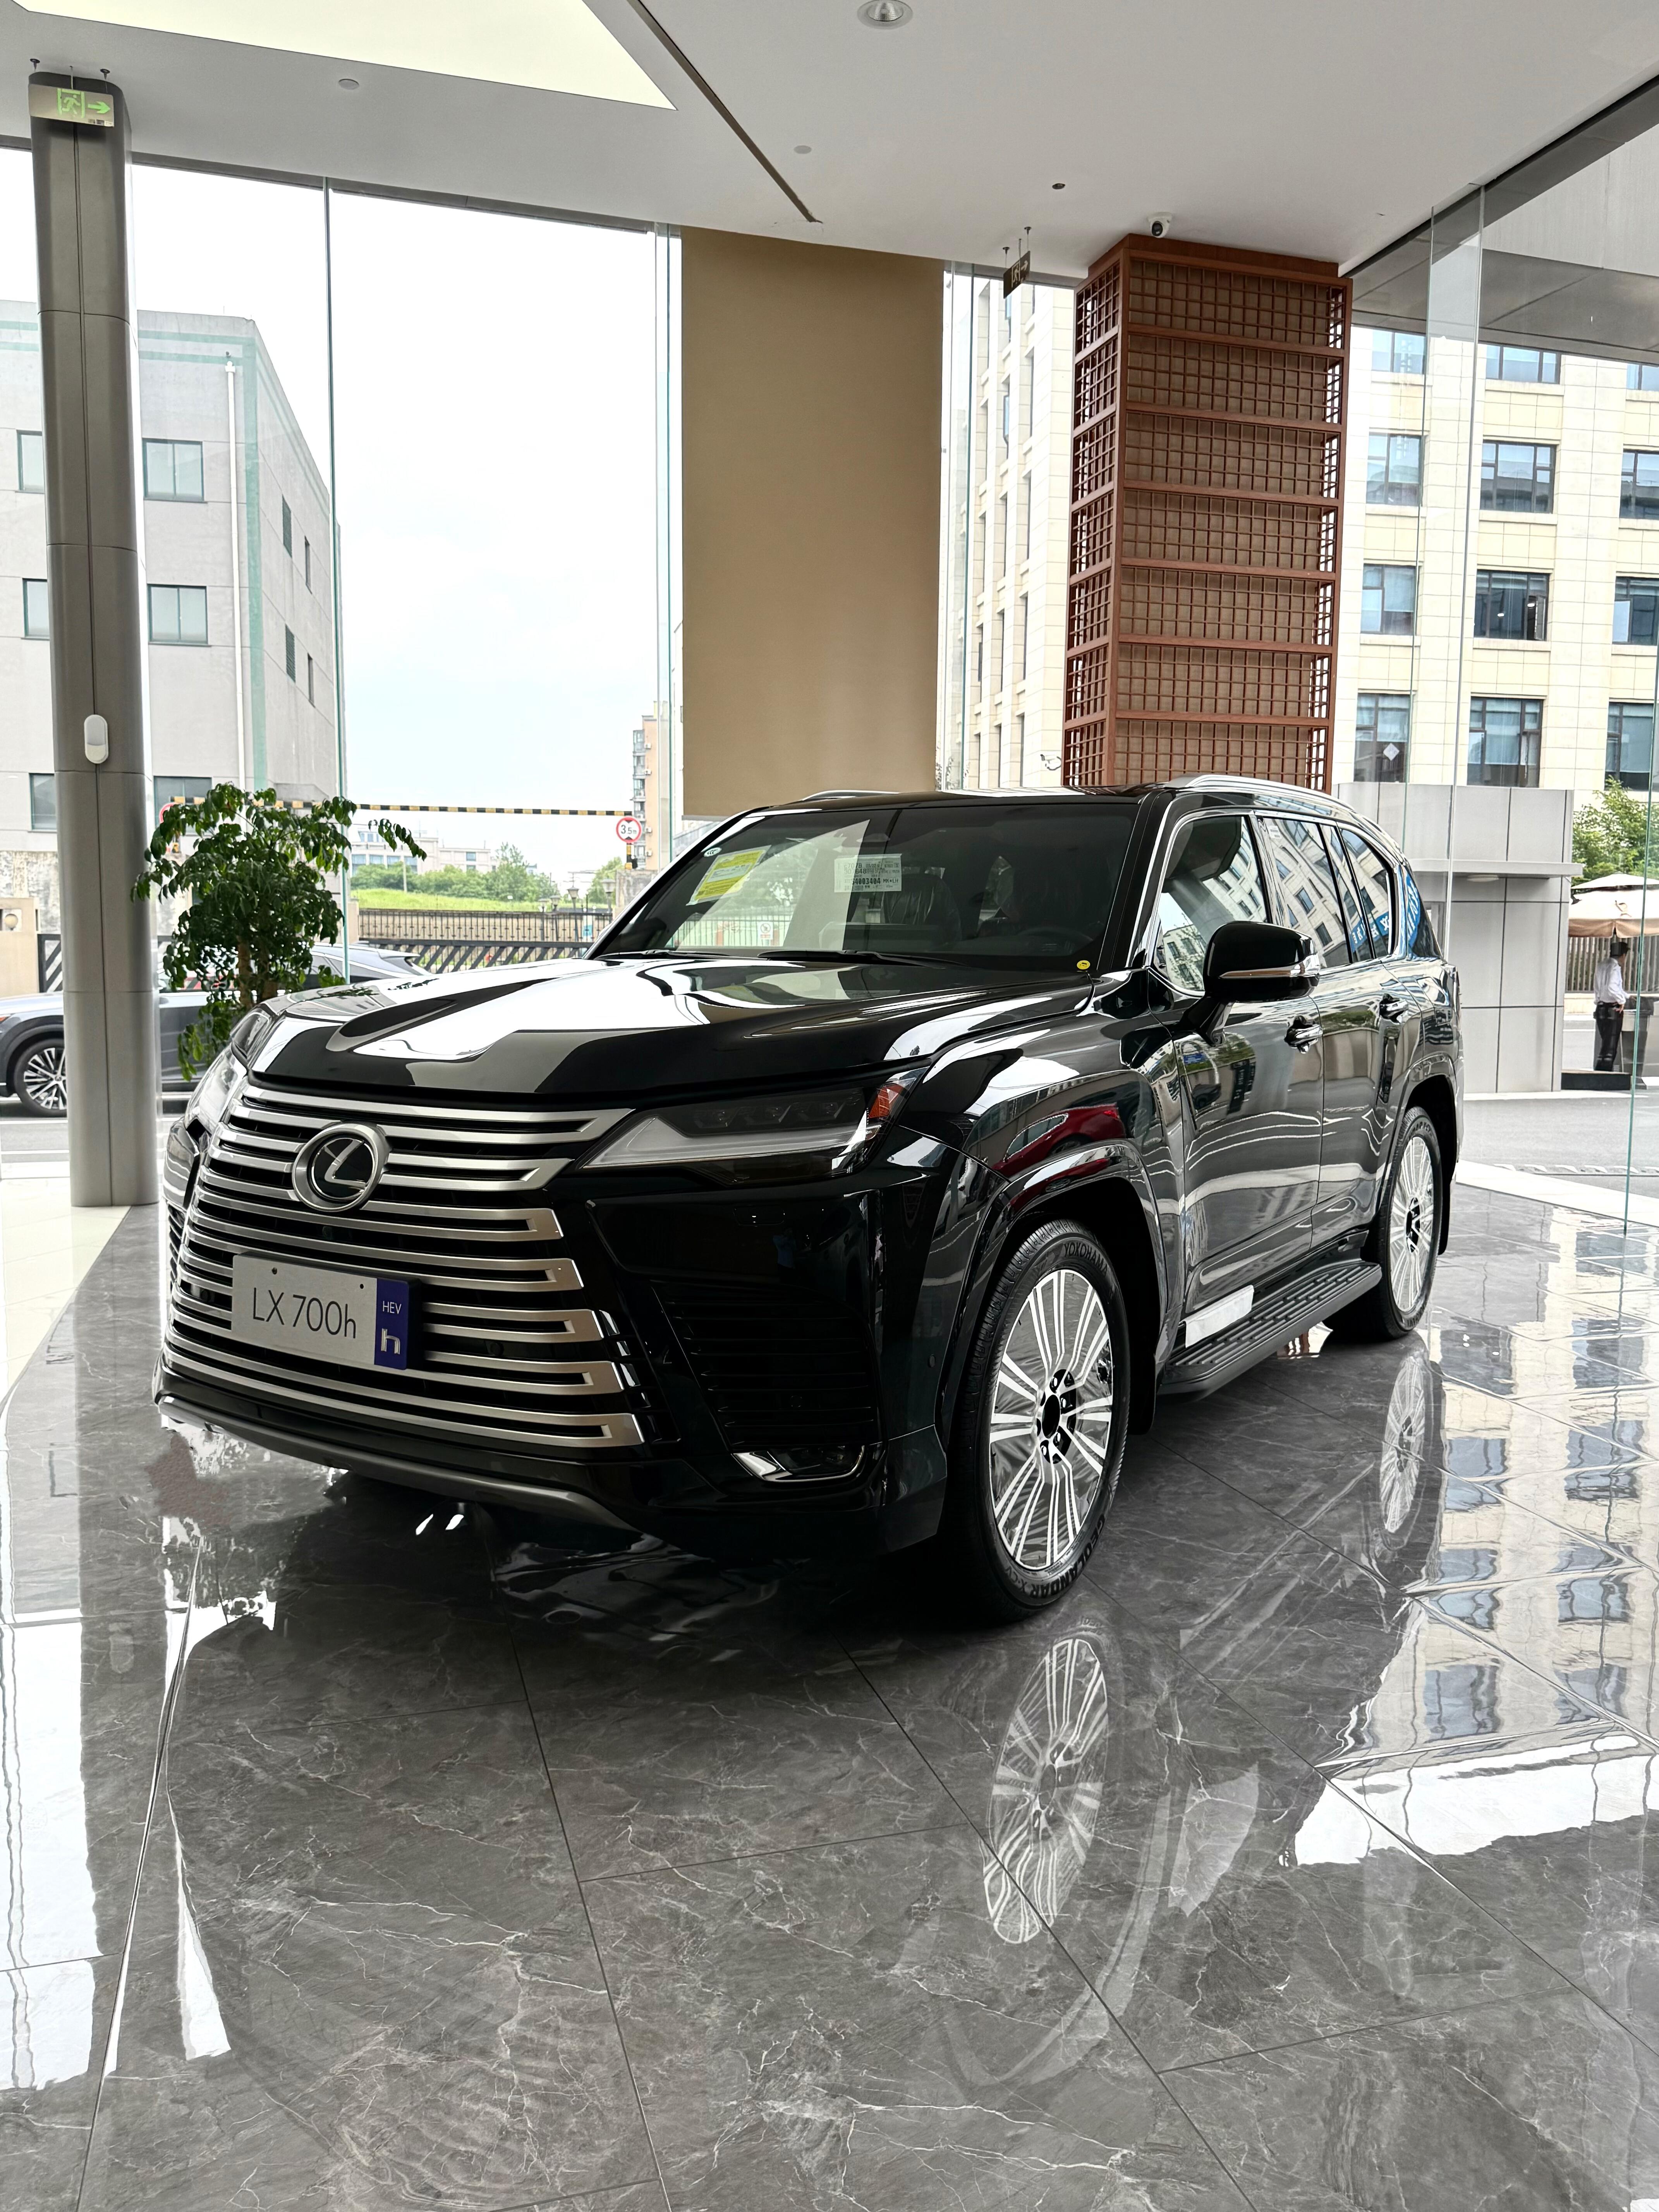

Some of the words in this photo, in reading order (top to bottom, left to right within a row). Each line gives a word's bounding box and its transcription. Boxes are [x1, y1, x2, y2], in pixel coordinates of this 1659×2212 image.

[1064, 1242, 1108, 1277] YOKOHAMA
[253, 1288, 285, 1325] LX
[293, 1294, 356, 1339] 700h
[383, 1300, 402, 1315] HEV
[381, 1328, 400, 1355] h
[1030, 1514, 1105, 1598] GEOLANDAR
